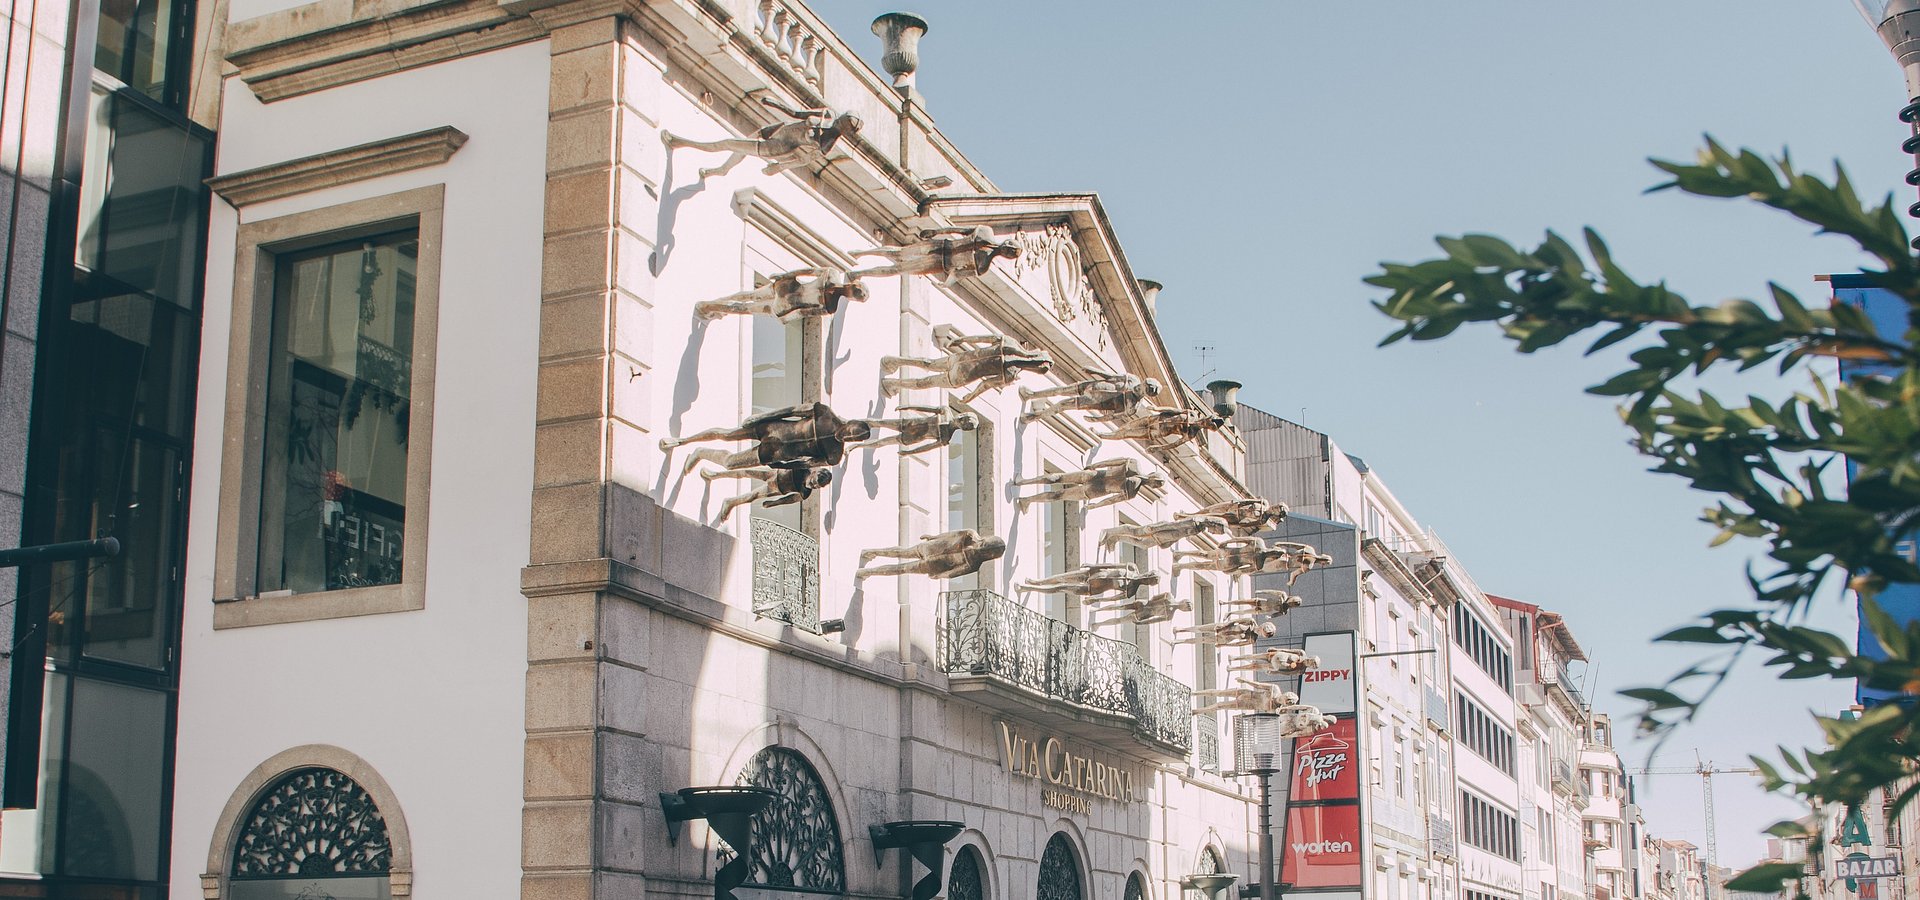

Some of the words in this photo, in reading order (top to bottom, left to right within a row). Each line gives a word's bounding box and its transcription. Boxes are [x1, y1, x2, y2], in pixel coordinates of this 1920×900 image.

[1304, 669, 1350, 683] ZIPPY
[1000, 721, 1042, 779] VIA
[1044, 737, 1134, 803] CATARINA
[1298, 752, 1347, 776] Pizza
[1306, 765, 1345, 787] Hut
[1044, 790, 1092, 816] SHOPPING
[1292, 840, 1353, 854] worten
[1837, 859, 1896, 877] BAZAR
